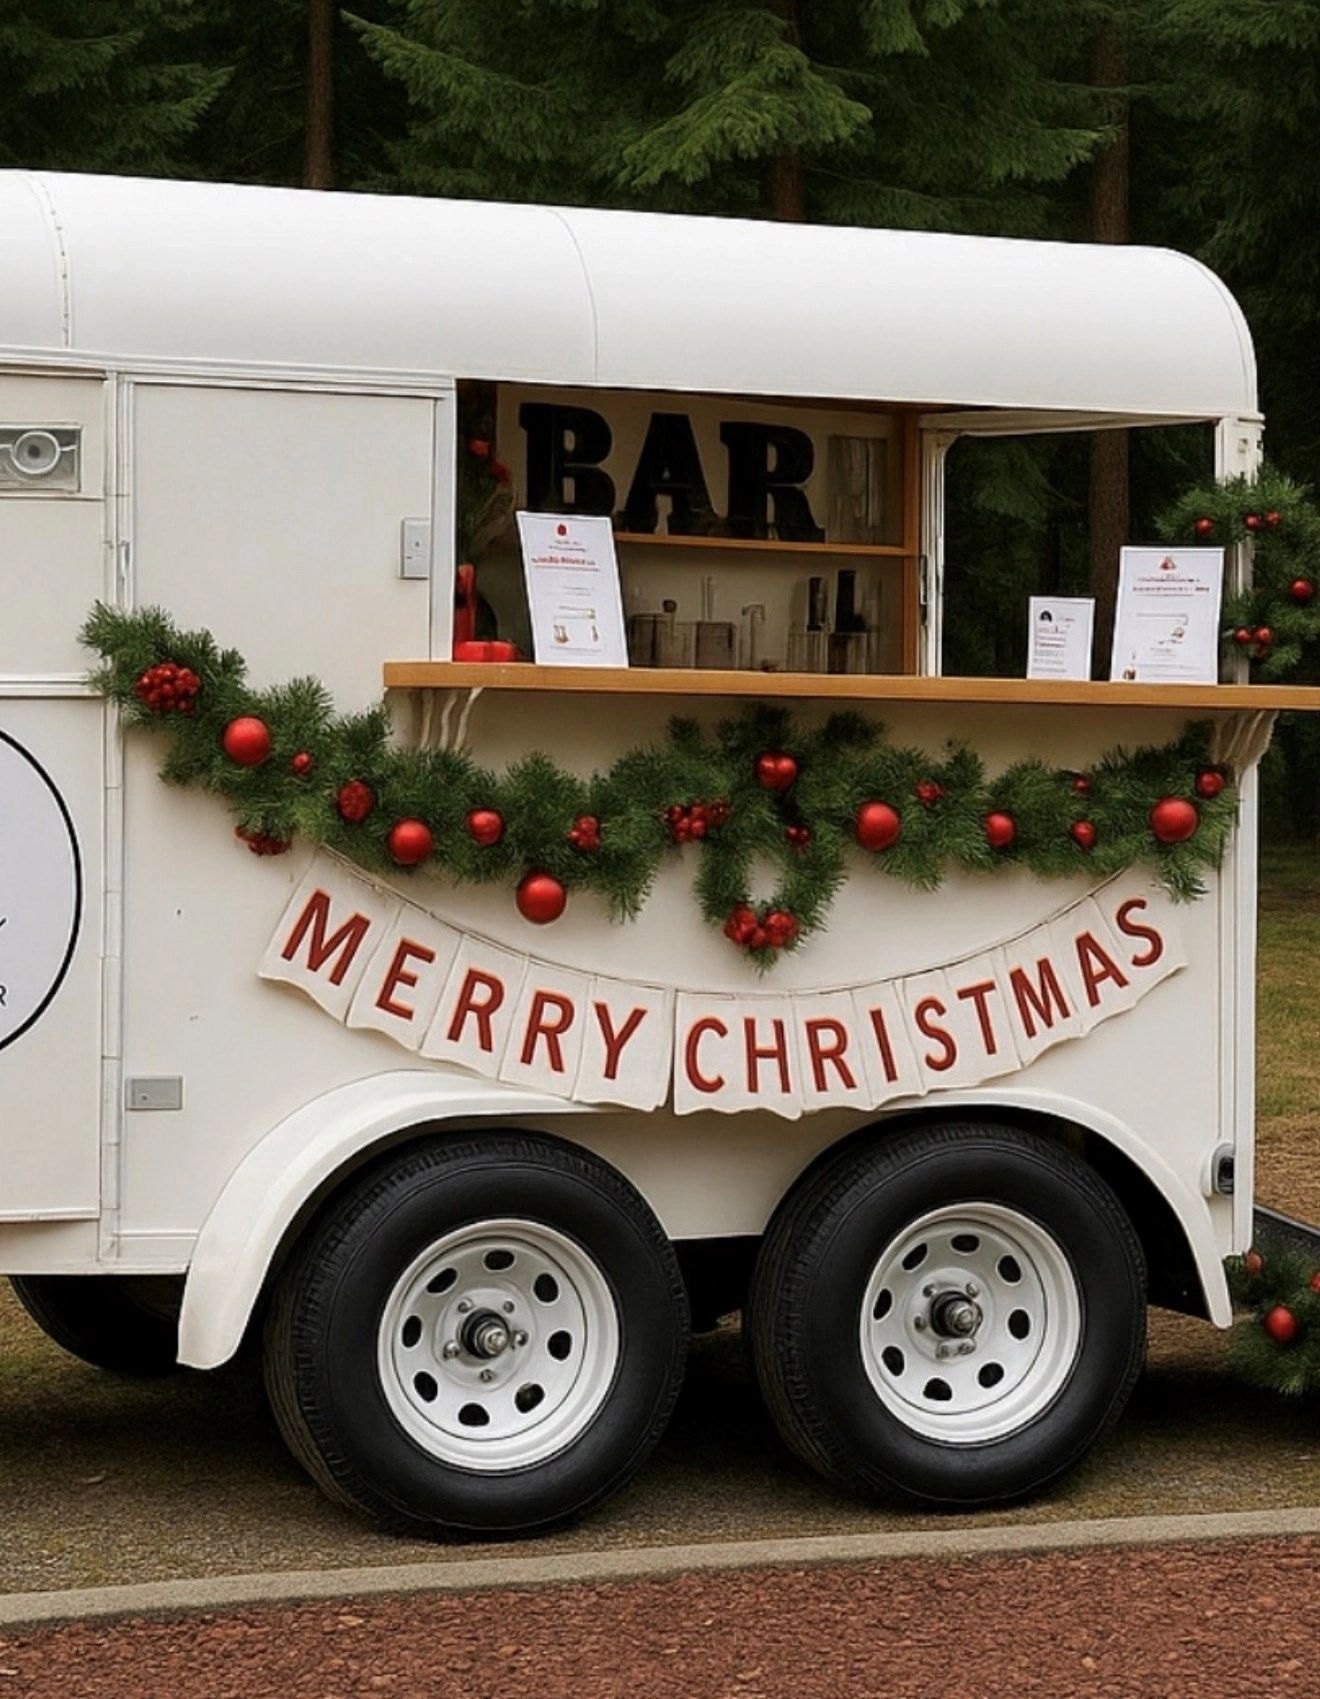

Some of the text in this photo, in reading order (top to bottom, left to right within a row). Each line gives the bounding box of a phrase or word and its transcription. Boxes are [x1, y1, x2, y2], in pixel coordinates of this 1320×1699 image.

[519, 402, 826, 543] BAR
[281, 891, 1164, 1092] MERRY CHRISTMAS
